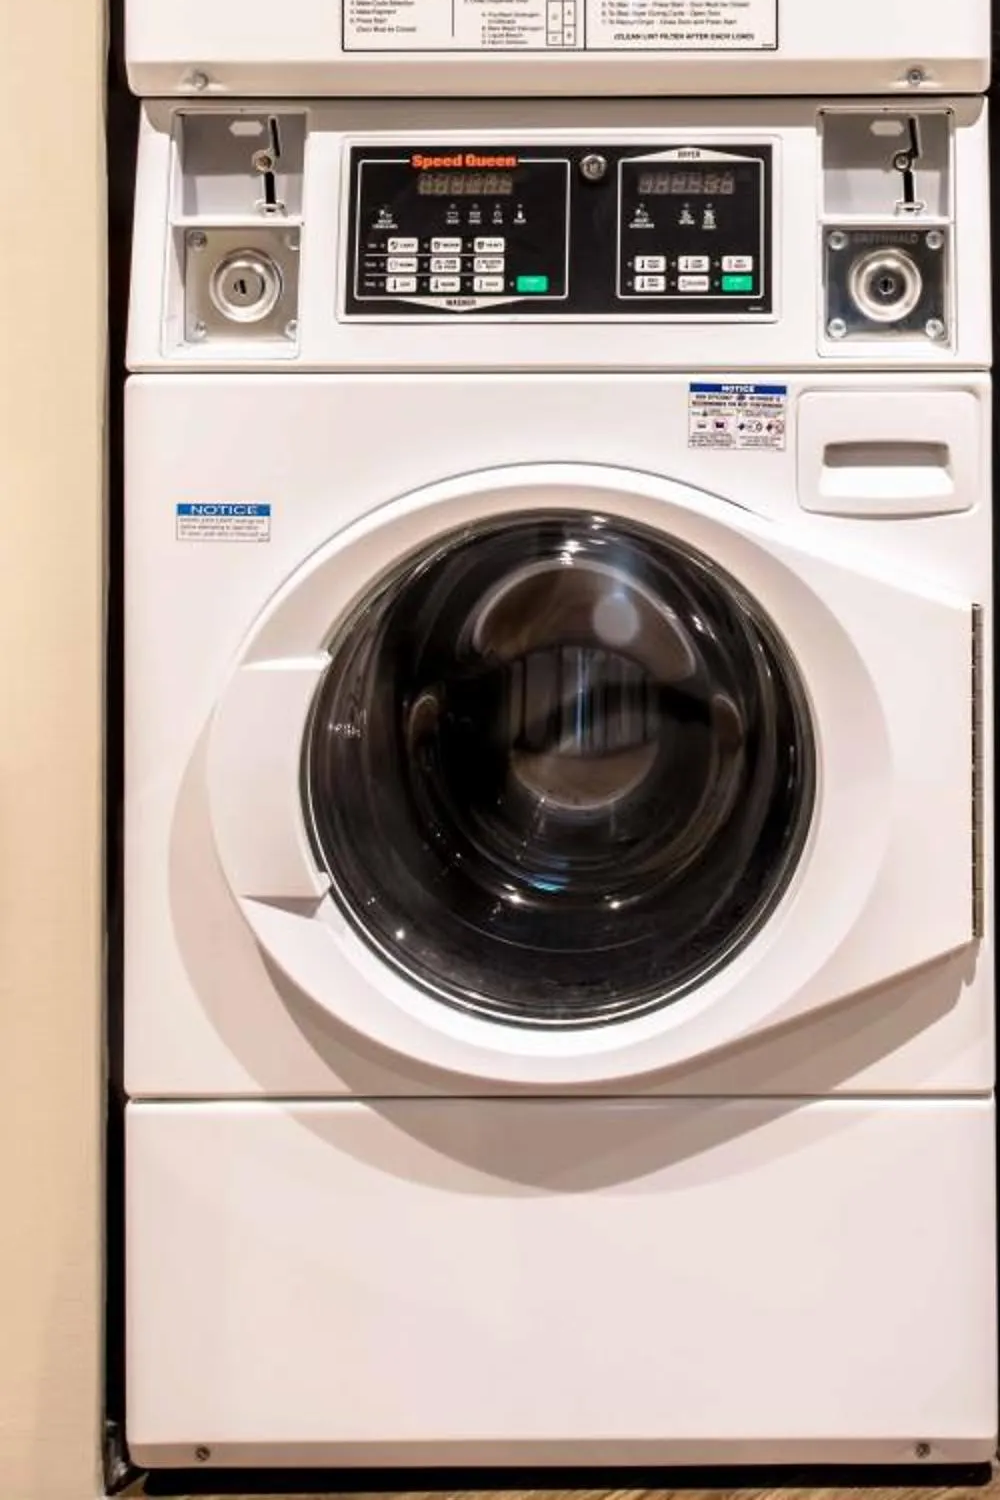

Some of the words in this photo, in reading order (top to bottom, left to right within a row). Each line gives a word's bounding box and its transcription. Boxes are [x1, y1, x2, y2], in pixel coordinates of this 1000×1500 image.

[412, 154, 463, 170] Speed
[465, 154, 517, 167] Queen
[721, 385, 755, 393] NOTICE
[191, 505, 257, 515] NOTICE
